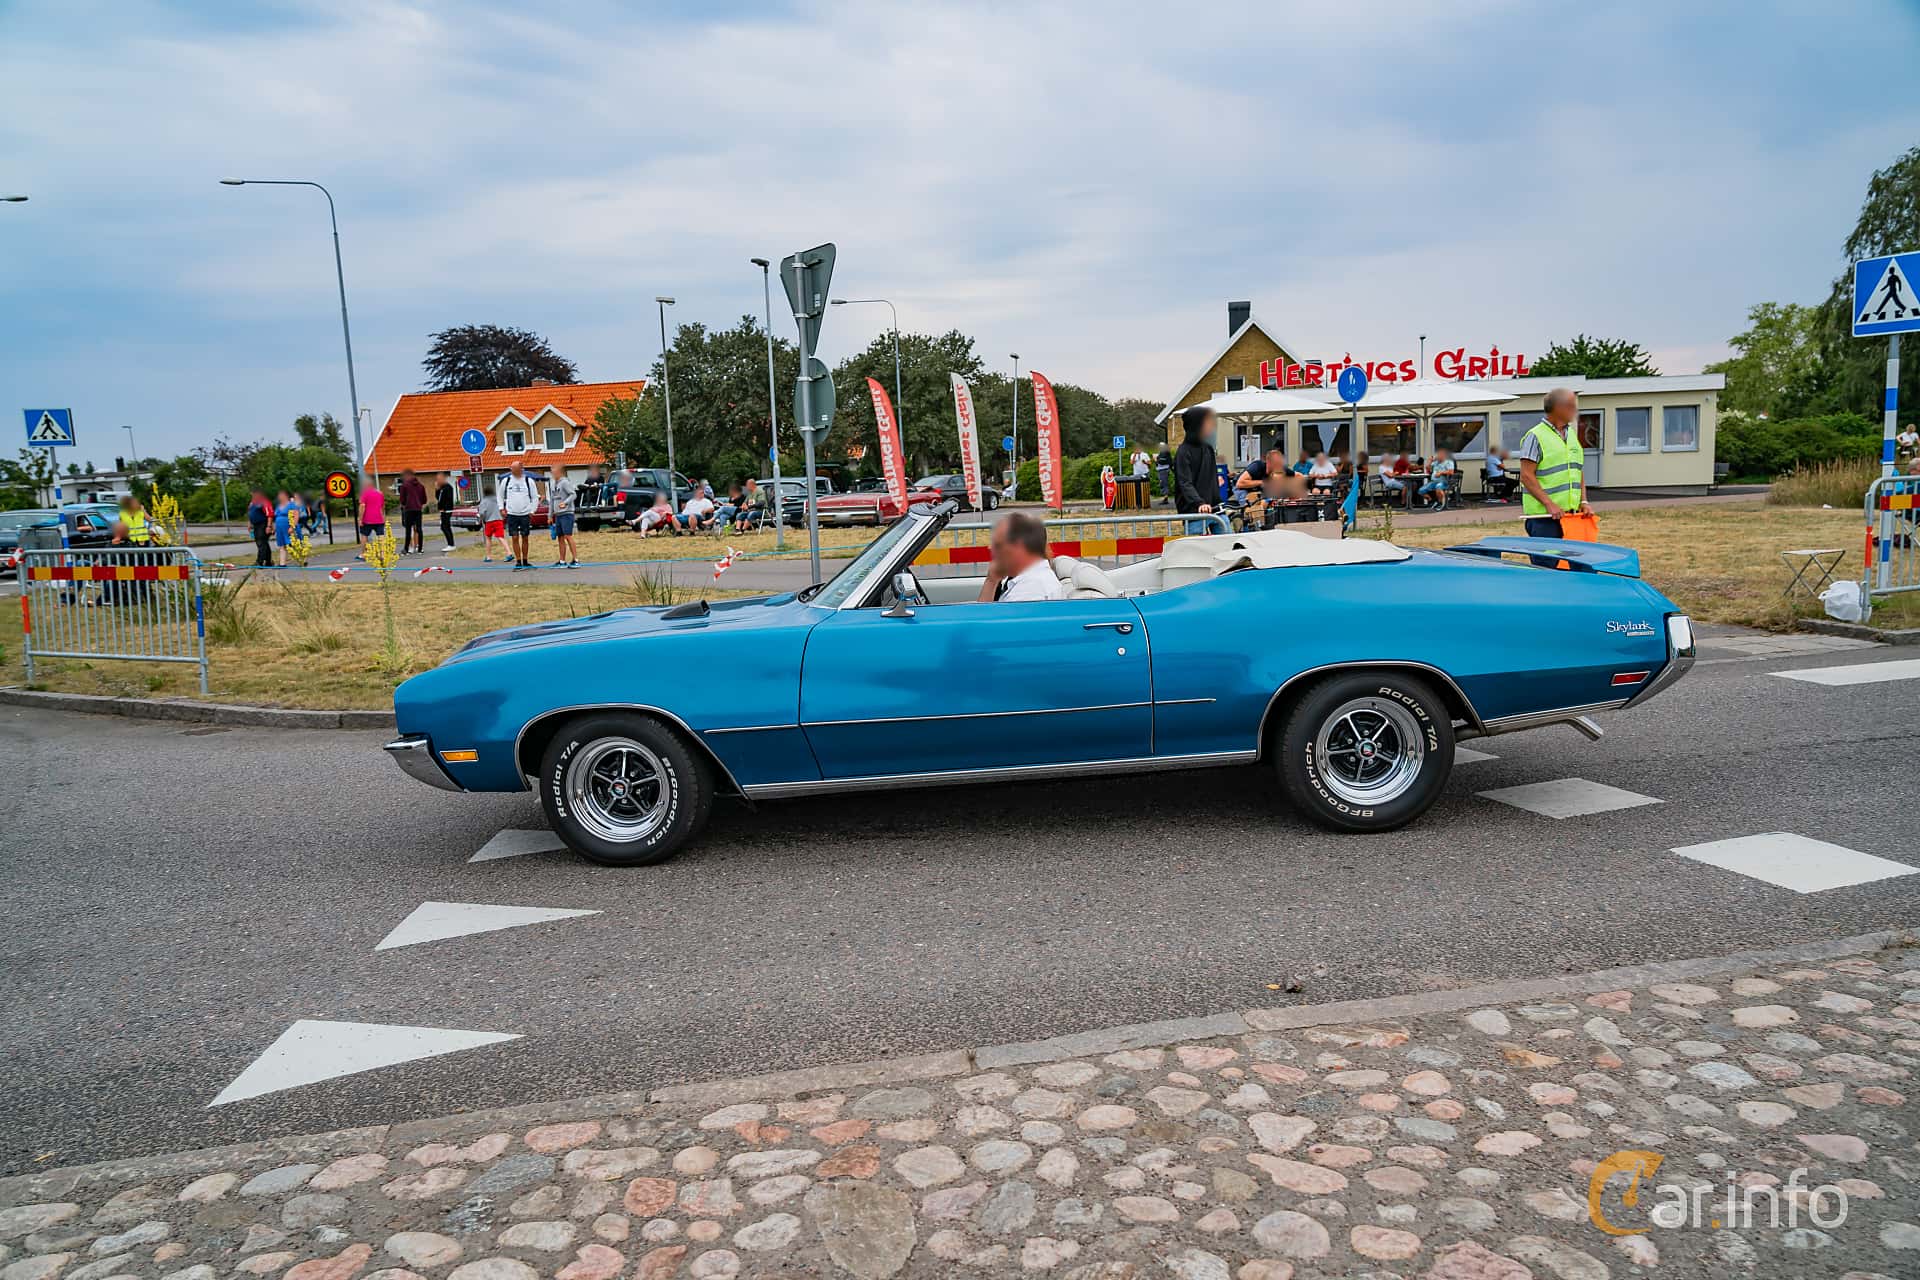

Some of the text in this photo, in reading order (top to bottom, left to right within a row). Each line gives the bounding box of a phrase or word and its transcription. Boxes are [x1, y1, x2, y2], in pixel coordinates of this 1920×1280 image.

[1433, 346, 1529, 382] GRILL
[331, 479, 347, 491] 30
[1606, 620, 1655, 633] Skylark
[1378, 687, 1438, 751] Radial T/A
[552, 741, 580, 818] Radial T/A
[647, 757, 678, 846] BFGoodrich
[1304, 742, 1375, 817] BFGoodrich
